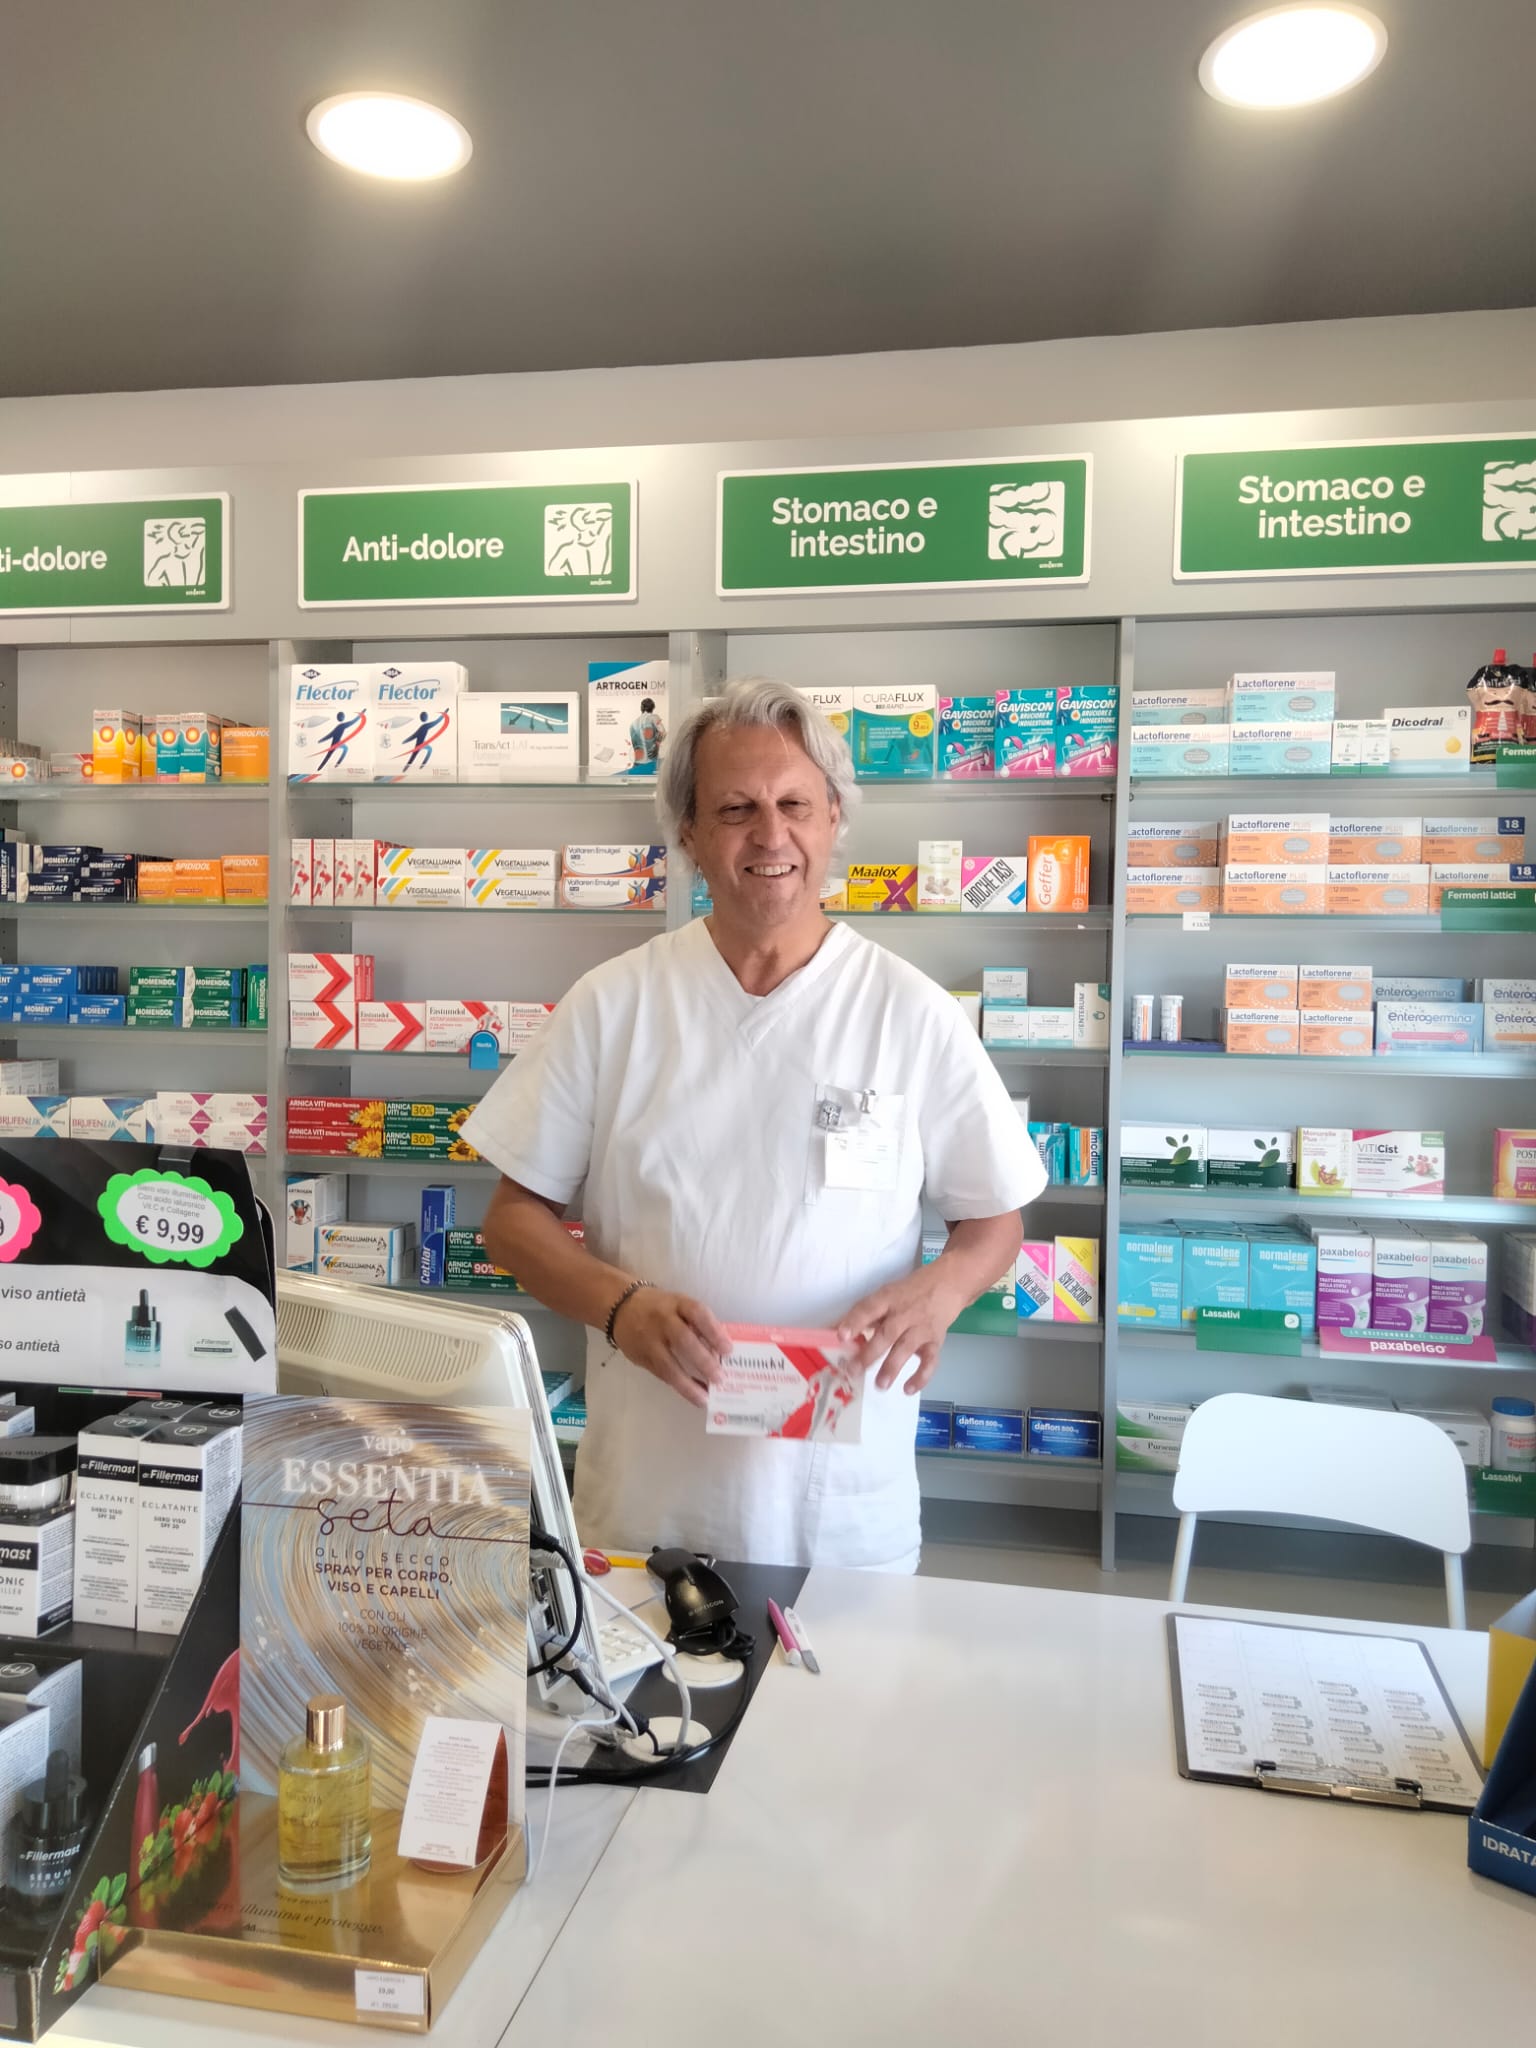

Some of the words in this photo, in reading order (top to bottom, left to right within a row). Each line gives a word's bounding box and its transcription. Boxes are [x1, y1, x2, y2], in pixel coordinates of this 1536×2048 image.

[1238, 476, 1397, 505] Stomaco
[1403, 478, 1425, 498] e
[772, 496, 911, 525] Stomaco
[917, 498, 937, 520] e
[1258, 508, 1412, 539] intestino
[342, 532, 504, 564] Anti-dolore
[790, 527, 926, 559] intestino
[596, 681, 648, 690] ARTROGEN
[650, 681, 666, 689] DM
[1237, 680, 1296, 689] Lactoflorene
[296, 685, 354, 700] Flector
[378, 684, 437, 700] Flector
[864, 693, 924, 703] CURAFLUX
[1132, 696, 1188, 705] Lactoflorene
[999, 702, 1054, 713] GAVISCON
[1060, 700, 1117, 710] GAVISCON
[942, 710, 995, 720] GAVISCON
[1392, 717, 1444, 727] Dicodral
[1133, 732, 1191, 741] Lactoflorene
[1233, 730, 1292, 739] Lactoflorene
[1232, 821, 1290, 829] Lactoflorene
[1425, 825, 1478, 833] Lactoflorene
[1505, 820, 1519, 828] 18
[407, 858, 462, 866] VEGETALLUMINA
[495, 859, 549, 867] VEGETALLUMINA
[851, 866, 900, 878] Maalox
[1228, 871, 1287, 880] Lactoflorene
[1517, 866, 1532, 875] 18
[1329, 872, 1389, 880] Lactoflorene
[1434, 872, 1489, 880] Lactoflorene
[964, 858, 1014, 908] BIOCHETASI
[1038, 858, 1052, 905] Geffer
[30, 884, 67, 892] MOMENTACT
[81, 886, 115, 894] MOMENTACT
[1448, 891, 1489, 900] Fermenti
[1491, 891, 1516, 900] lattici
[1229, 968, 1278, 977] Lactoflorene
[1303, 968, 1352, 978] Lactoflorene
[137, 977, 176, 986] MOMENDOL
[196, 979, 231, 987] MOMENDOL
[1376, 986, 1456, 999] enterogermina
[135, 1008, 173, 1016] MOMENDOL
[195, 1009, 230, 1017] MOMENDOL
[1230, 1012, 1279, 1022] Lactoflorene
[1303, 1014, 1353, 1023] Lactoflorene
[1388, 1012, 1472, 1024] enterogermina
[413, 1105, 433, 1115] 30%
[413, 1135, 433, 1144] 30%
[1358, 1144, 1399, 1154] VITICist
[136, 1215, 149, 1234] €
[157, 1218, 204, 1244] 9,99
[1127, 1242, 1174, 1253] normalene
[1193, 1247, 1240, 1257] normalene
[1320, 1247, 1370, 1257] paxabelGO
[1260, 1250, 1308, 1261] normalene
[1377, 1252, 1428, 1263] paxabelGO
[1433, 1255, 1484, 1265] paxabelGO
[421, 1246, 431, 1284] Cetilar
[474, 1264, 495, 1274] 90%
[2, 1288, 32, 1301] viso
[37, 1288, 86, 1303] antietà
[1203, 1309, 1240, 1319] Lassativi
[16, 1340, 60, 1353] antietà
[1370, 1341, 1445, 1353] paxabelGO
[959, 1416, 983, 1427] daflon
[1034, 1422, 1060, 1432] daflon
[282, 1458, 494, 1506] ESSENTIA
[1482, 1472, 1522, 1483] Lassativi
[317, 1488, 446, 1537] seta
[315, 1547, 365, 1561] OLIO
[381, 1552, 449, 1566] SECCO
[315, 1563, 360, 1577] SPRAY
[365, 1567, 393, 1579] PER
[398, 1569, 453, 1585] CORPO,
[328, 1581, 361, 1594] VISO
[367, 1584, 374, 1594] E
[380, 1585, 439, 1599] CAPELLI
[360, 1609, 383, 1620] CON
[387, 1612, 406, 1622] OLI
[338, 1623, 365, 1633] 100%
[382, 1627, 428, 1639] ORIGINE
[355, 1639, 410, 1650] VEGETALE
